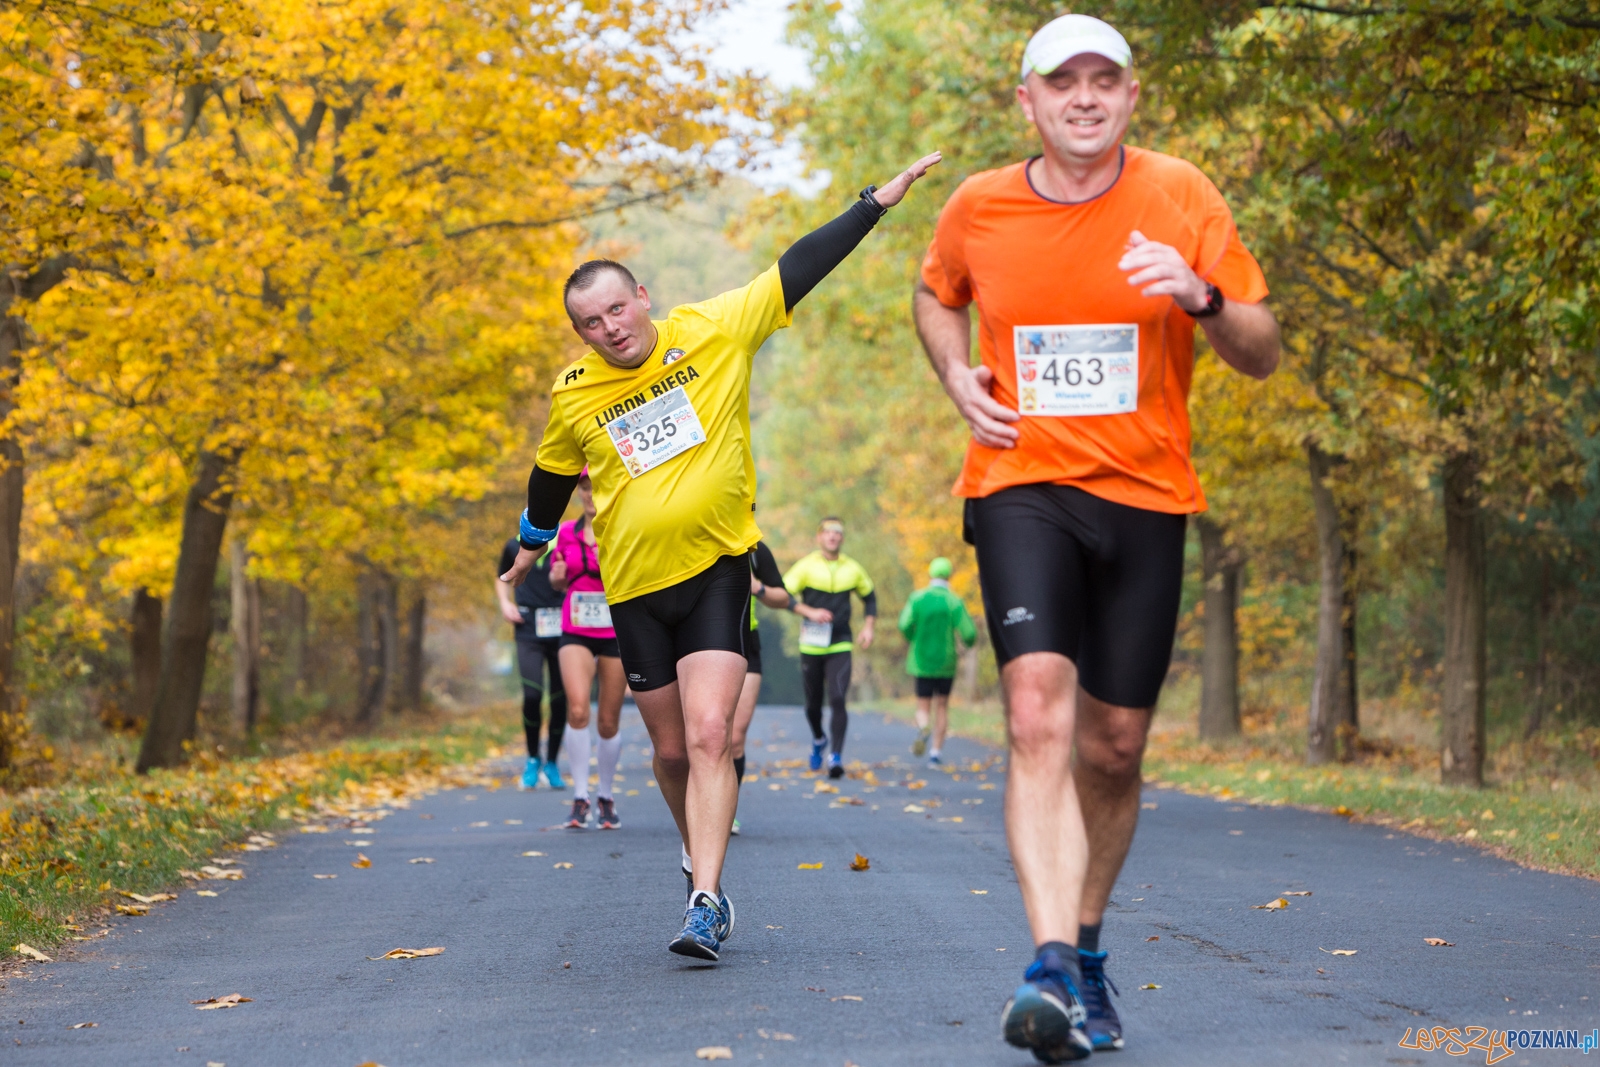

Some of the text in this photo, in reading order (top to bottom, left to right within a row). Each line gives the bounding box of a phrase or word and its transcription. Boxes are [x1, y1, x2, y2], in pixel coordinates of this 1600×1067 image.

[1042, 358, 1104, 386] 463
[595, 366, 700, 428] LUBOŃ BIEGA
[633, 416, 677, 451] 325
[651, 441, 673, 456] Robert
